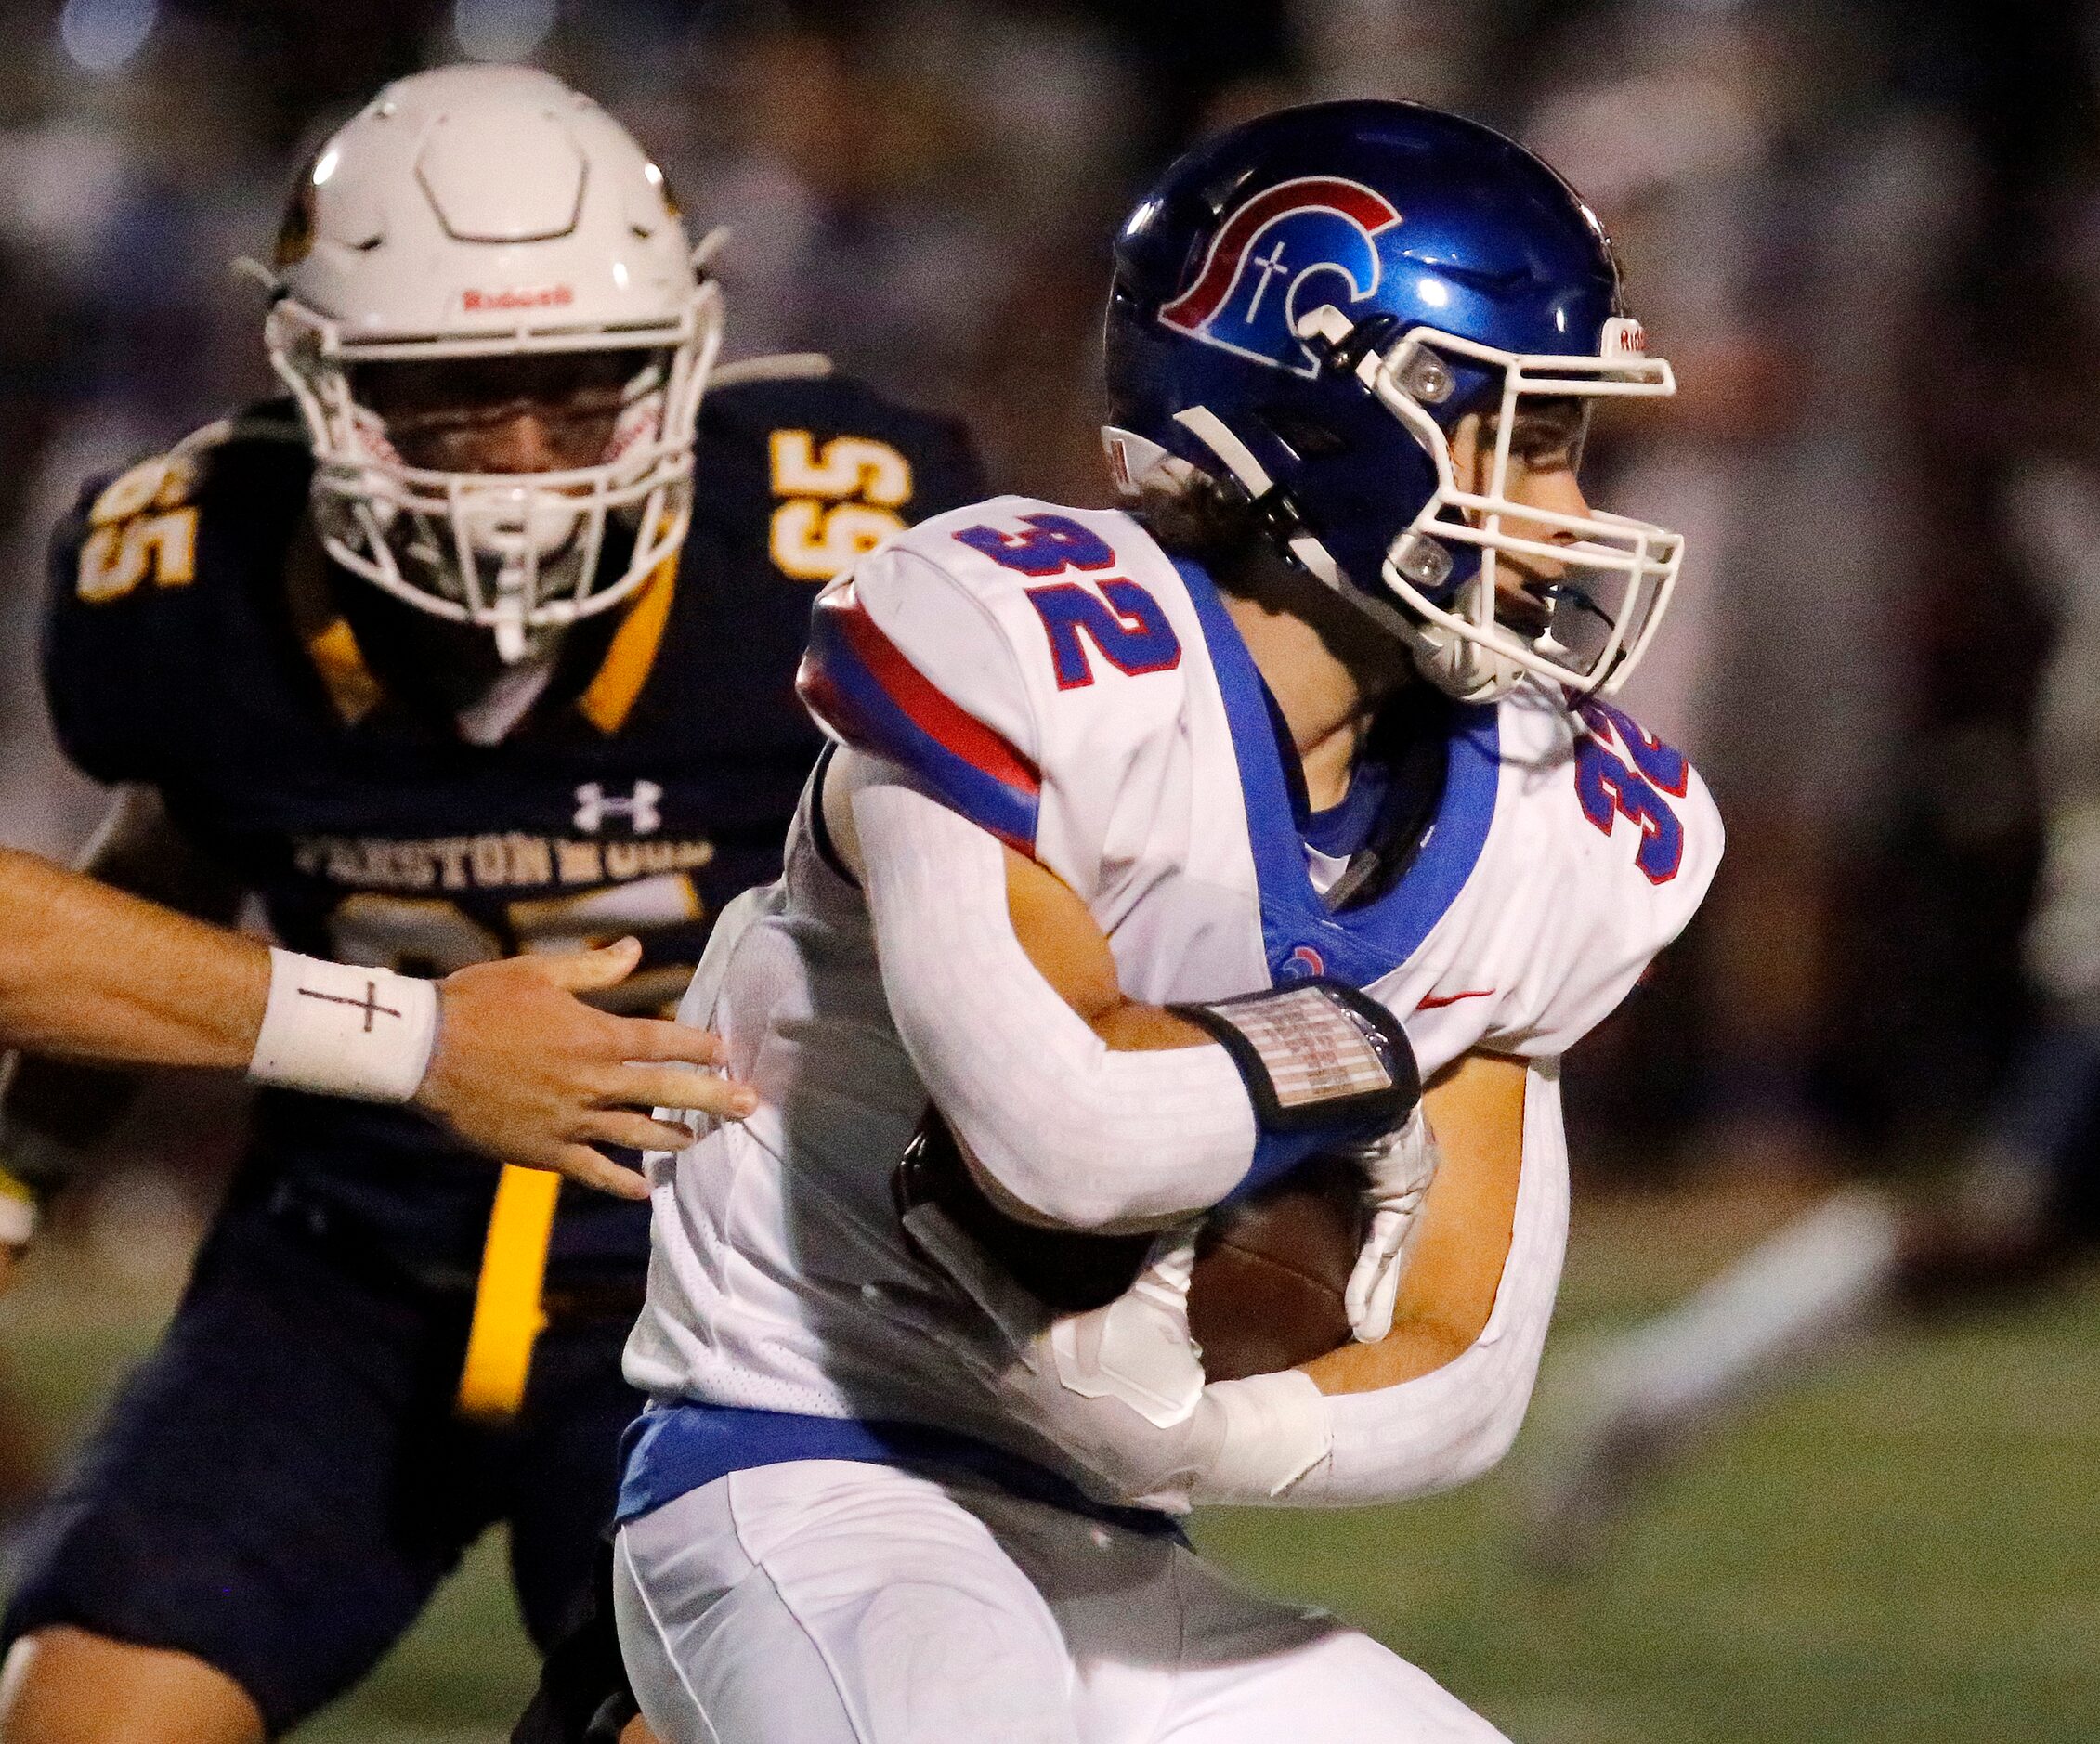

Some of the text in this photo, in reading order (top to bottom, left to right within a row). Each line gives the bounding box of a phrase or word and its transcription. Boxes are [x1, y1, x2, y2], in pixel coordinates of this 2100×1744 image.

[769, 428, 913, 579] 65
[951, 512, 1181, 691] 32
[1573, 697, 1689, 885] 32
